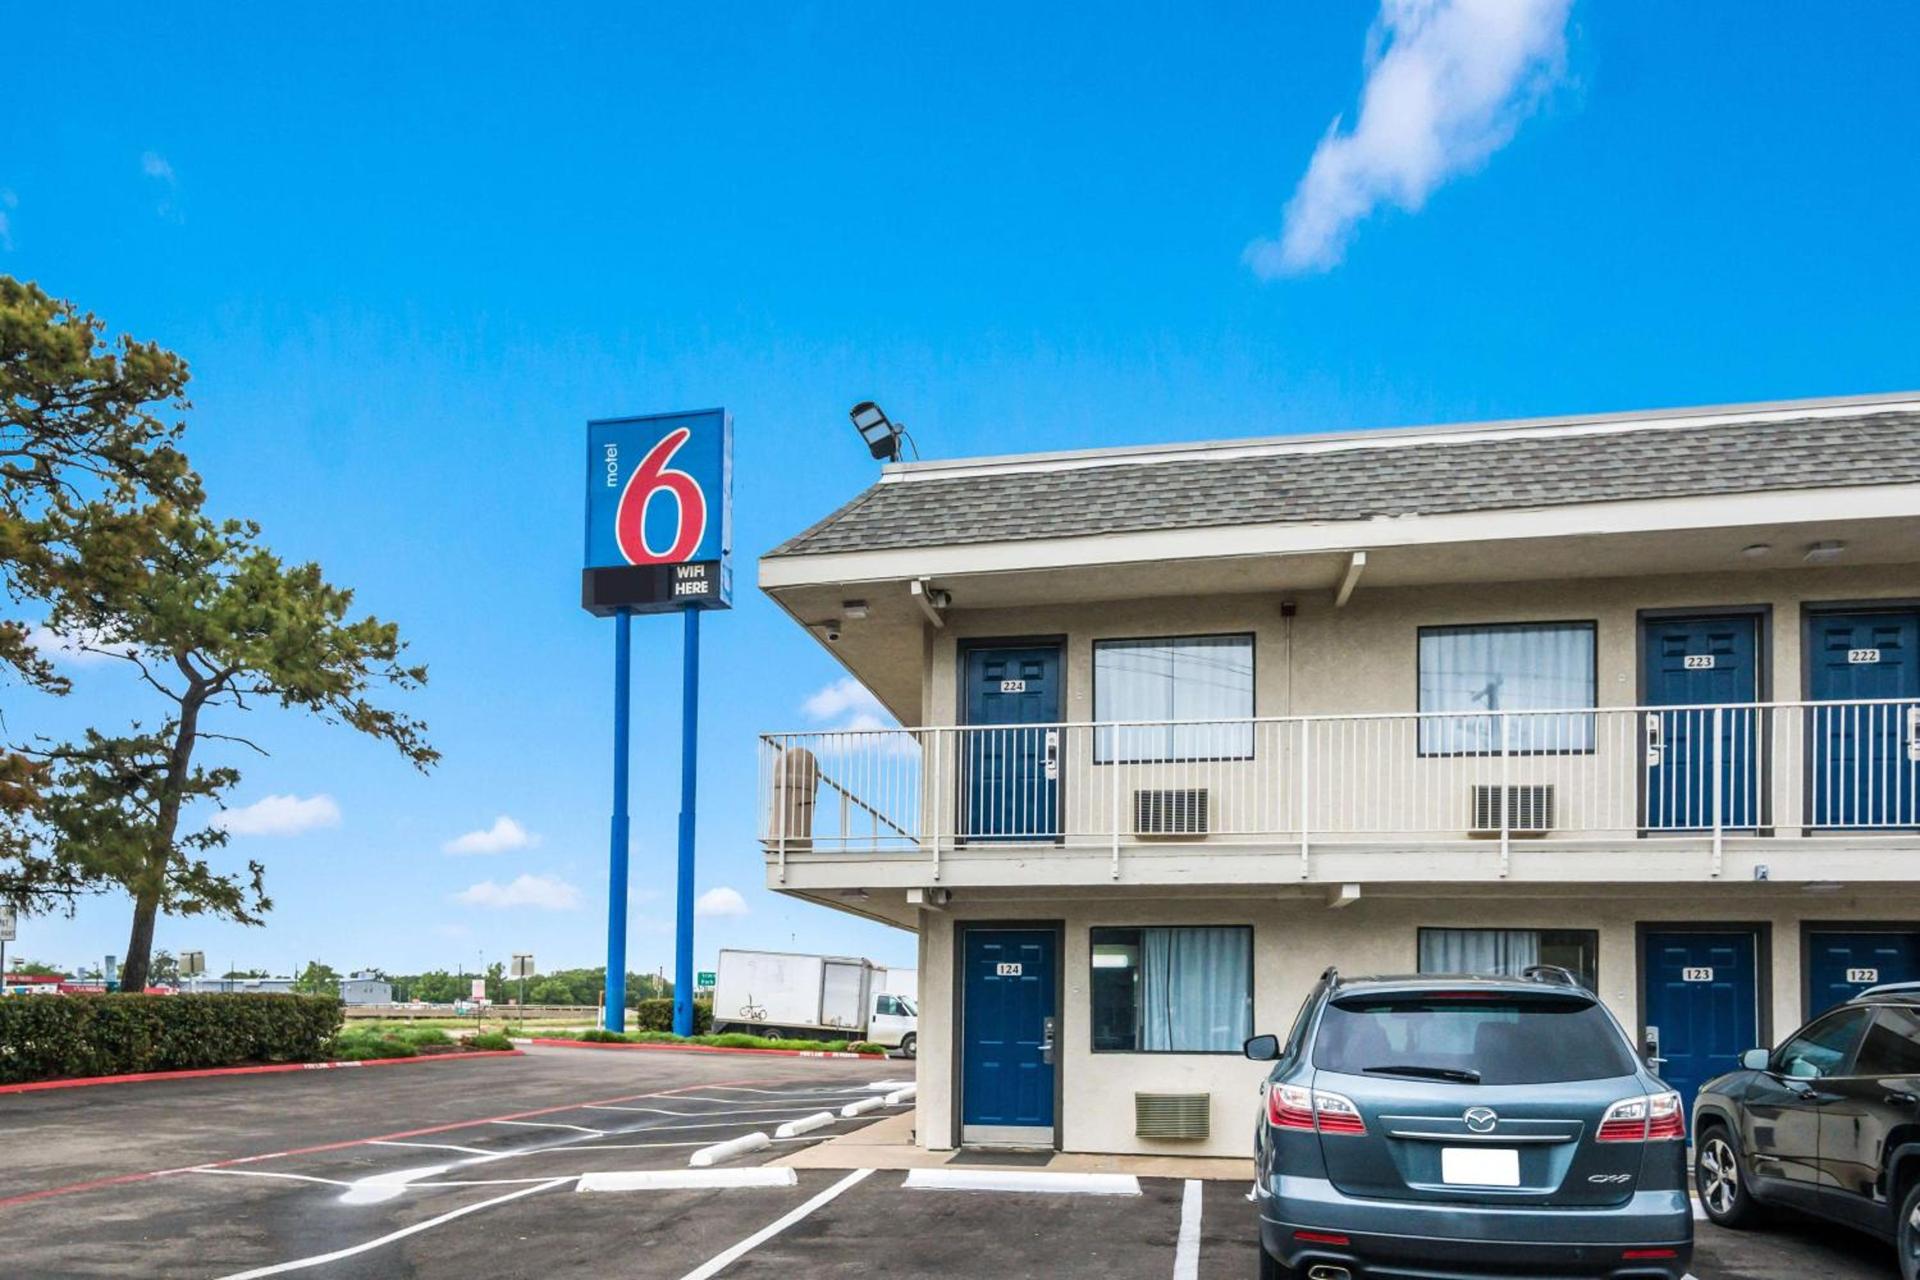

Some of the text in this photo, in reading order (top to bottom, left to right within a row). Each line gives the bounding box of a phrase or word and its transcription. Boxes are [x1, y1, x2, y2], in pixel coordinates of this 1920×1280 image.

[604, 443, 617, 487] motel
[615, 426, 707, 566] 6
[677, 564, 705, 578] WIFI
[675, 581, 708, 595] HERE
[1852, 650, 1877, 661] 222
[1687, 657, 1711, 667] 223
[1004, 681, 1023, 691] 224
[1000, 964, 1019, 975] 124
[1687, 969, 1710, 980] 123
[1851, 971, 1875, 982] 122
